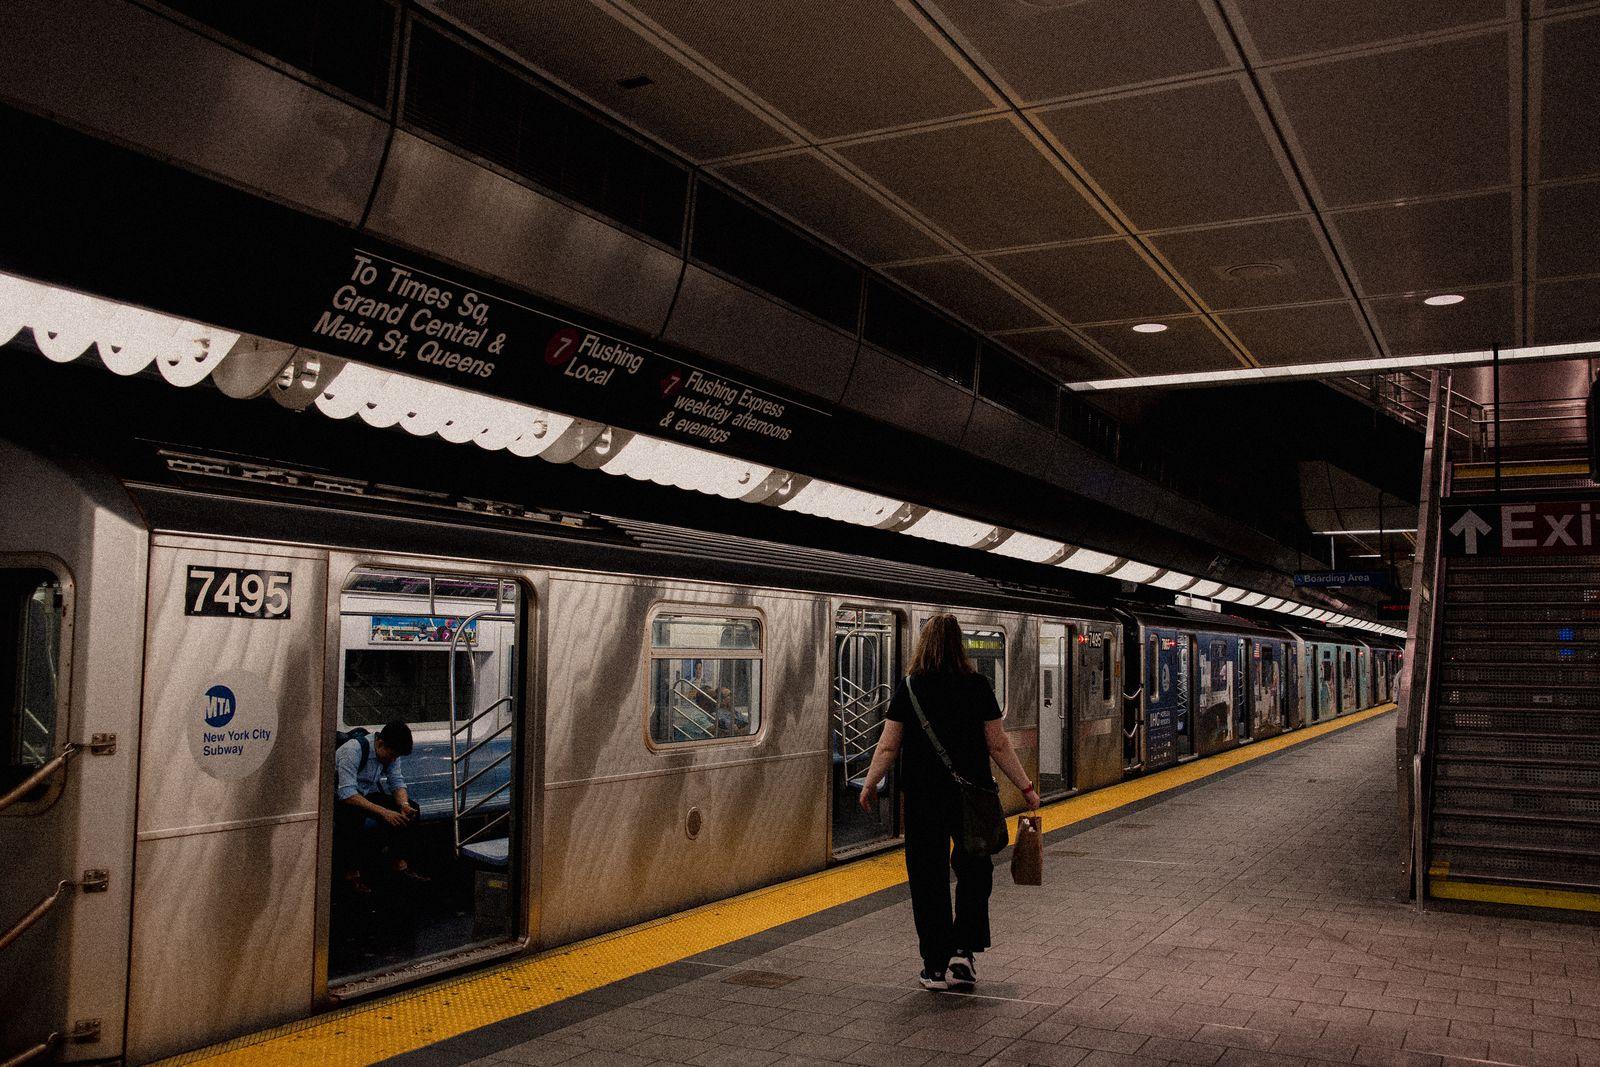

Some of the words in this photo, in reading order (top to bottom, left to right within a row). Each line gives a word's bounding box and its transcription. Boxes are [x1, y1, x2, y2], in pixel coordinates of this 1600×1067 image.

[350, 254, 378, 286] To
[386, 267, 453, 309] Times
[457, 292, 491, 326] Sq,
[332, 284, 408, 325] Grand
[409, 308, 489, 349] Central
[488, 332, 508, 355] &
[312, 310, 374, 346] Main
[377, 328, 408, 360] St,
[416, 340, 496, 378] Queens
[553, 337, 572, 358] 7
[577, 333, 645, 375] Flushing
[563, 355, 616, 386] Local
[663, 375, 680, 394] 7
[684, 370, 738, 406] Flushing
[738, 388, 786, 418] Express
[659, 410, 674, 429] &
[675, 416, 732, 444] evenings
[673, 394, 732, 426] weekday
[731, 411, 793, 441] afternoons
[1501, 503, 1600, 547] Exi
[190, 570, 290, 616] 7495
[1304, 574, 1346, 584] Boarding
[1347, 574, 1370, 582] Area
[204, 695, 231, 719] MTA
[203, 732, 226, 743] New
[228, 730, 250, 742] York
[252, 728, 271, 742] City
[203, 744, 244, 756] Subway
